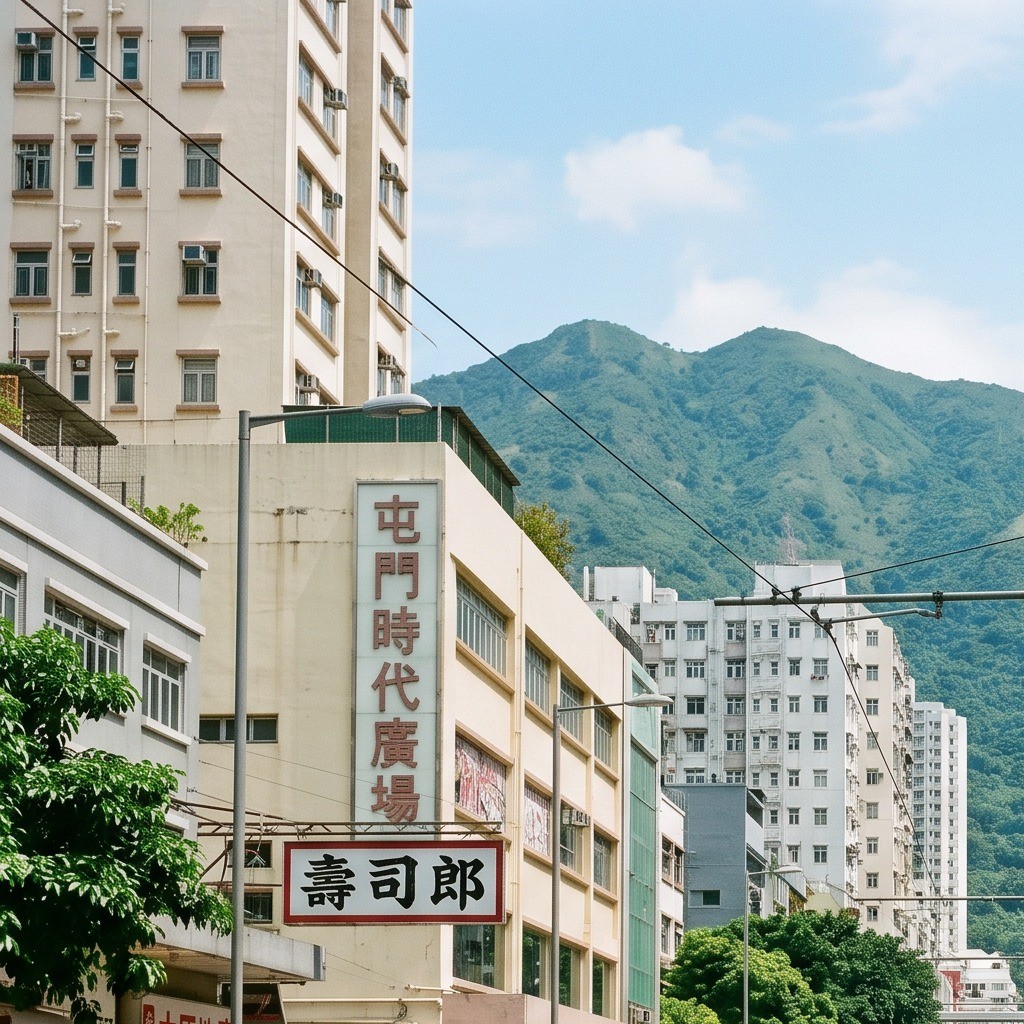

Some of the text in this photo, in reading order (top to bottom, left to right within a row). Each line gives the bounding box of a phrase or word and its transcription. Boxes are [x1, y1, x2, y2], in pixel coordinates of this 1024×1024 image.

[371, 494, 421, 823] 屯門時代廣場
[300, 853, 486, 911] 壽司郎
